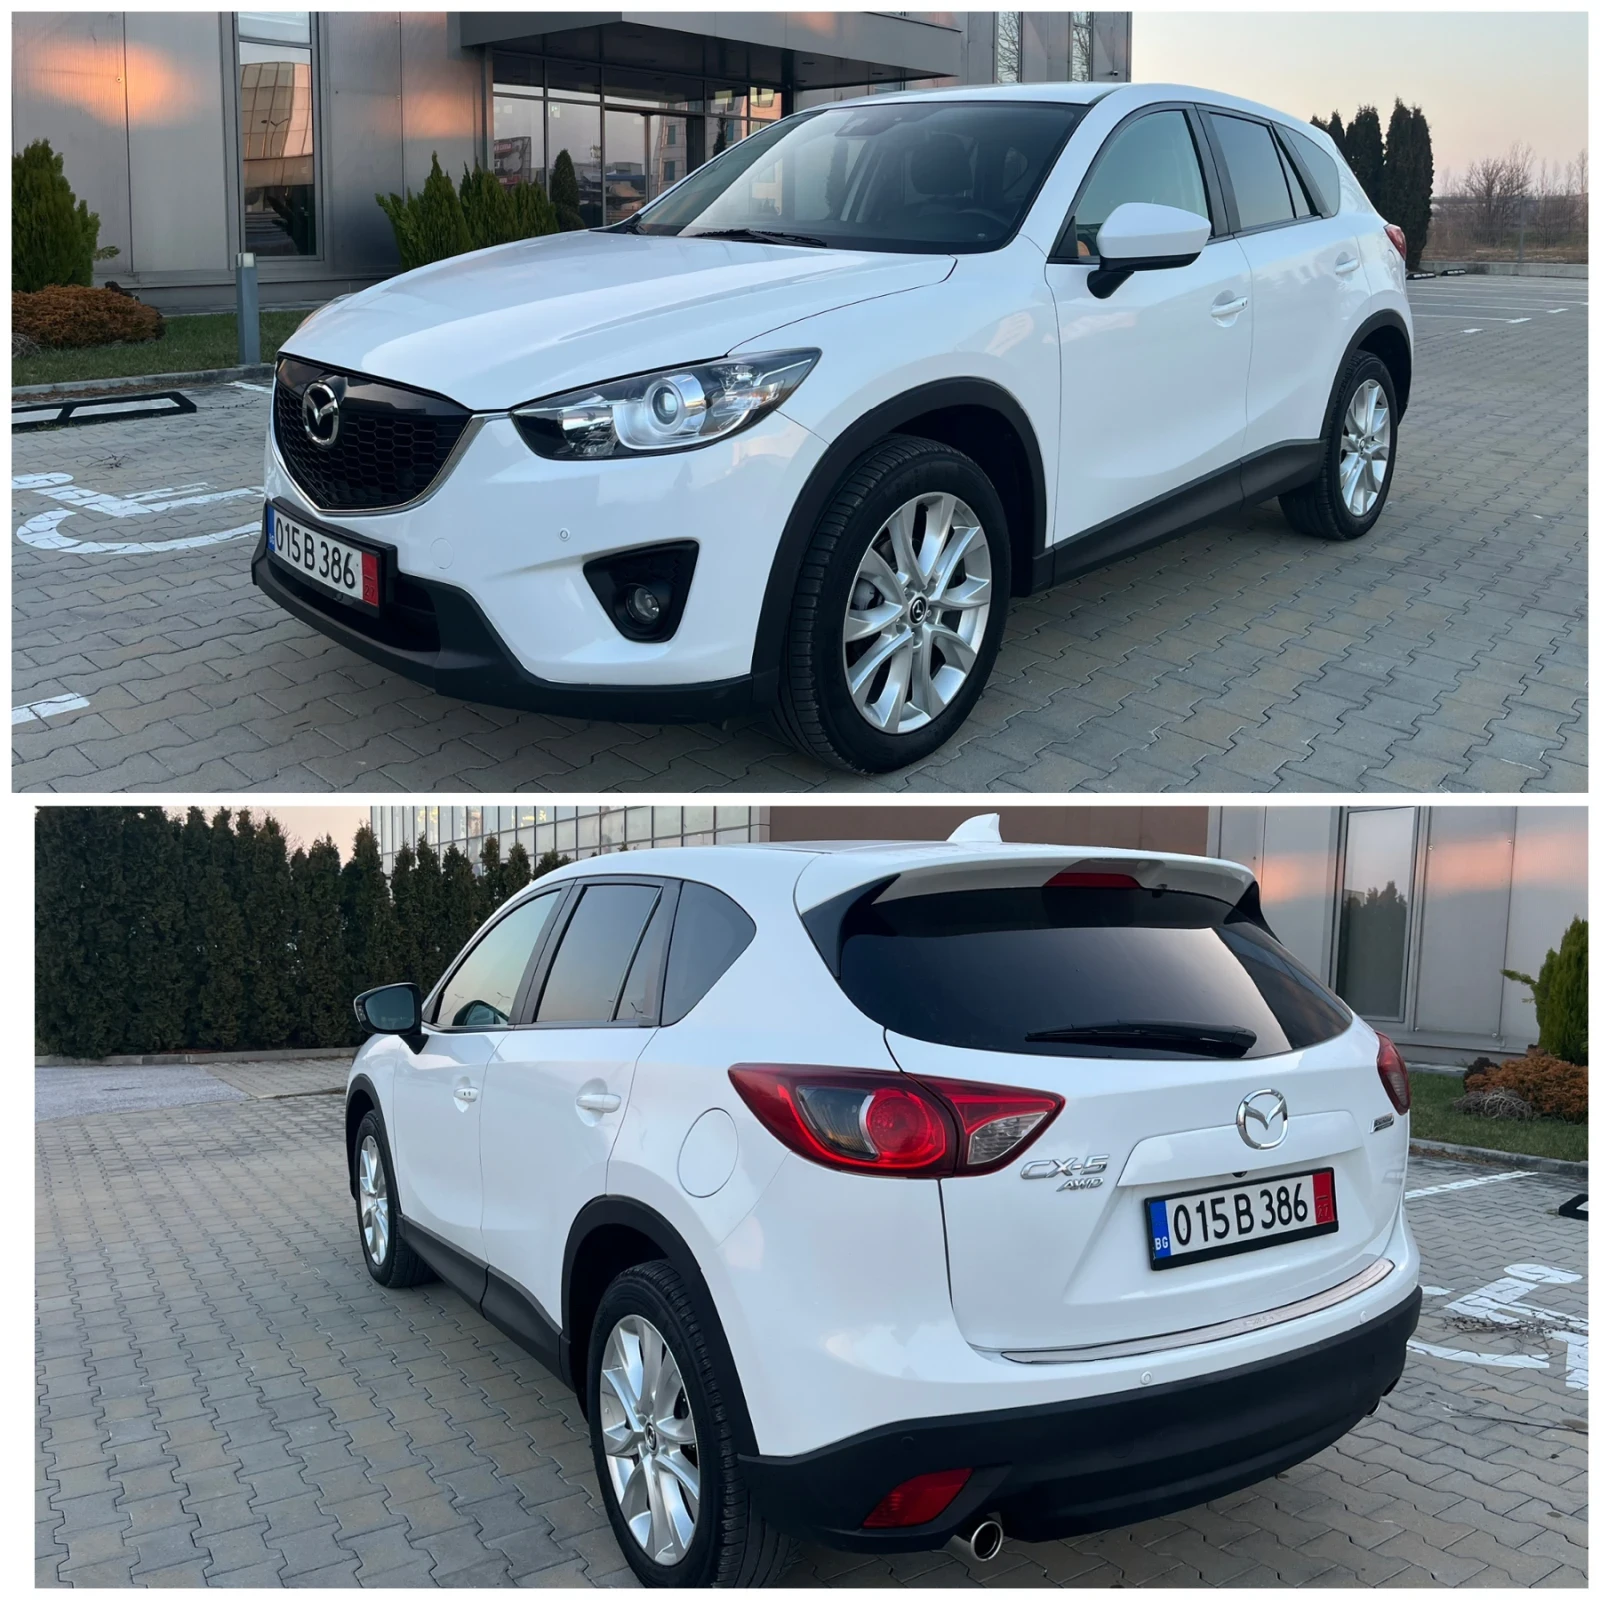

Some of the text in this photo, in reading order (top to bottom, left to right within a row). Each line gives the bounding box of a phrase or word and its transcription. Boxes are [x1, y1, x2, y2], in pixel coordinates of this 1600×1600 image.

[1020, 1154, 1110, 1180] CX-5
[1056, 1176, 1104, 1192] AWD
[1154, 1236, 1169, 1250] BG
